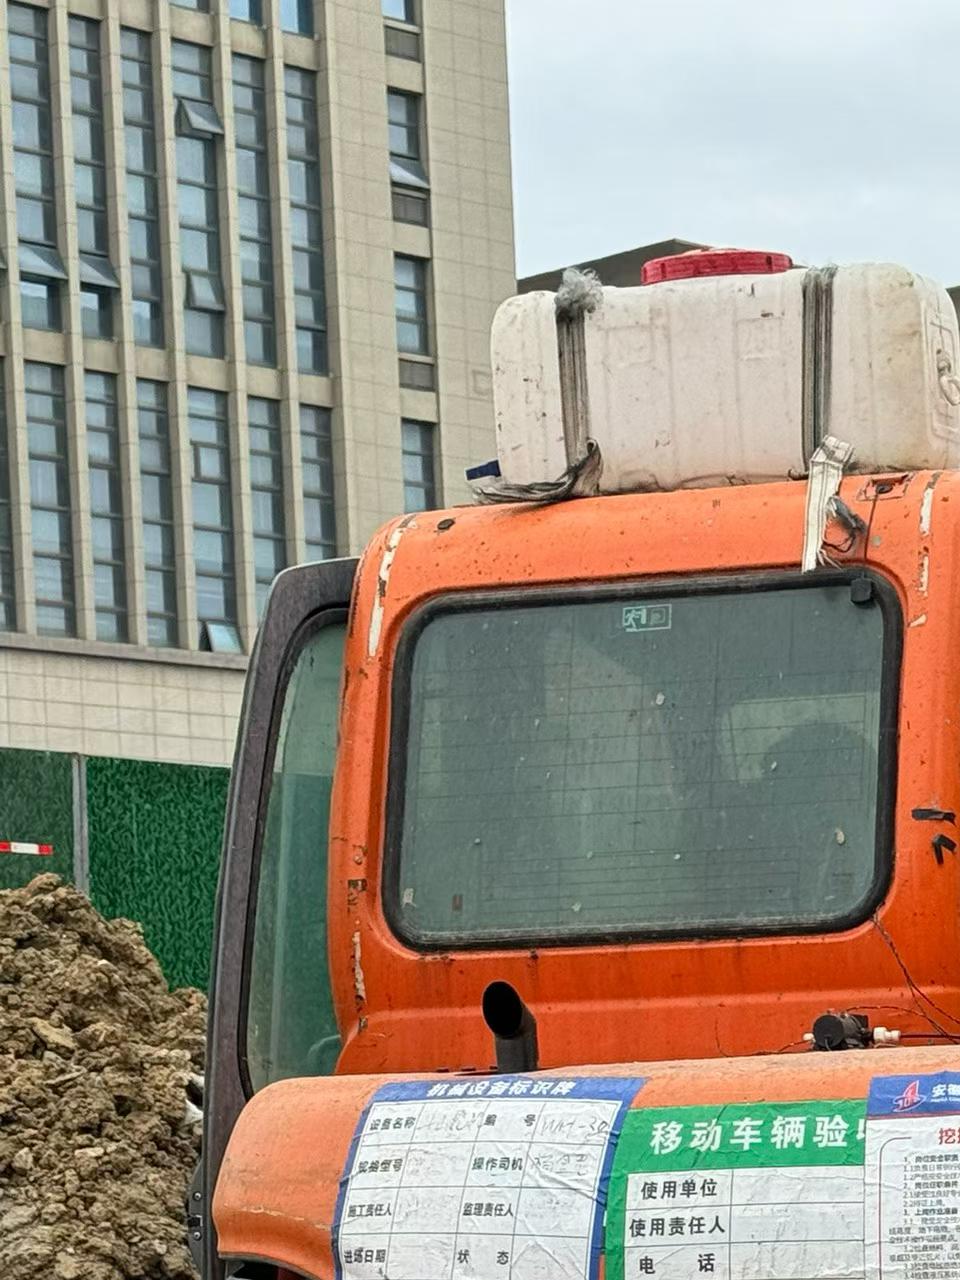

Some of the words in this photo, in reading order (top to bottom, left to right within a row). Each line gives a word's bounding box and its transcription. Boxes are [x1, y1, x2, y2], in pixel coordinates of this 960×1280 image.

[426, 1081, 577, 1097] 机械设备标识牌
[472, 1156, 523, 1171] 操作司机
[641, 1178, 718, 1199] 使用单位
[347, 1203, 392, 1218] 施工责任人
[463, 1203, 514, 1218] 监理责任人
[629, 1216, 725, 1237] 使用责任人
[343, 1248, 387, 1264] 进场日期
